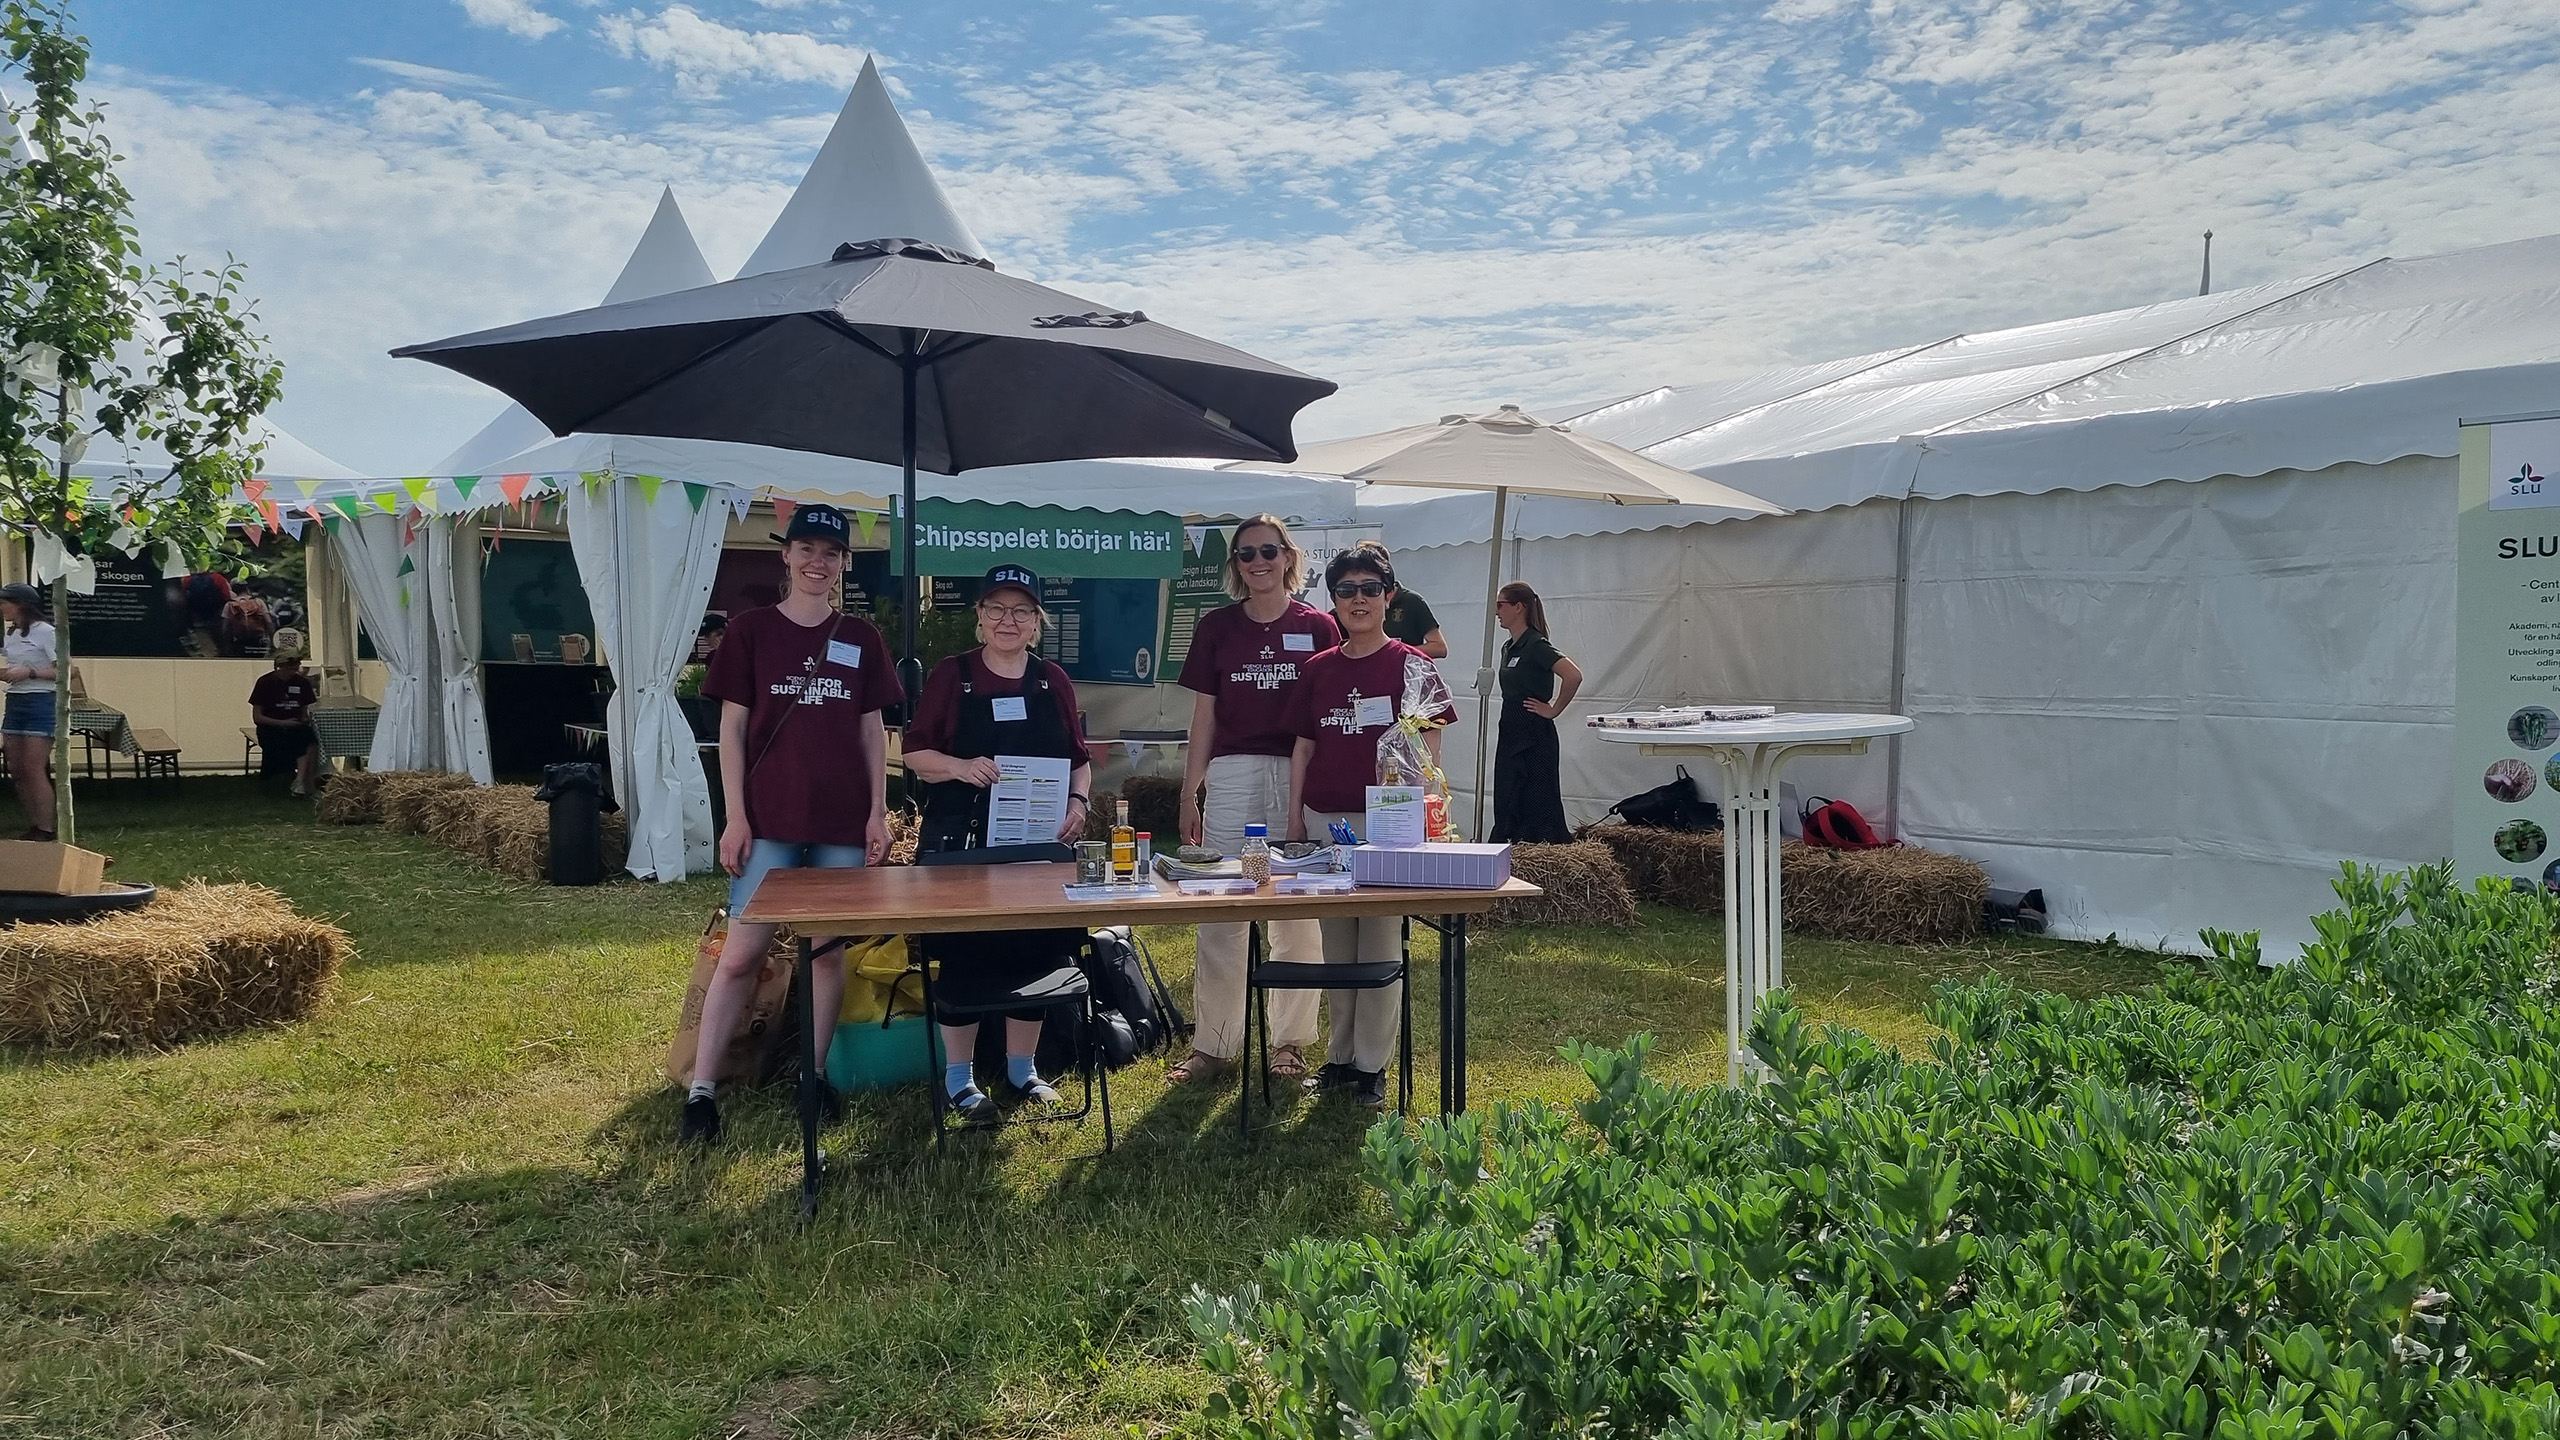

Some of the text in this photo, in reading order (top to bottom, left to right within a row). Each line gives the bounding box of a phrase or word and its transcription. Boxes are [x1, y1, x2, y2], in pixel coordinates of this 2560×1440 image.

[2511, 484, 2541, 495] SLU
[807, 512, 842, 530] SLU
[915, 524, 1171, 554] Chipsspelet börjar här!
[2498, 536, 2559, 559] SLU
[95, 560, 114, 569] sar
[101, 570, 145, 582] skogen
[1182, 565, 1200, 577] esign
[995, 569, 1031, 585] SLU
[1189, 578, 1218, 588] landskap
[2540, 594, 2555, 603] av
[2509, 622, 2550, 630] Akademi,
[2524, 633, 2536, 641] för
[2508, 648, 2554, 657] Utveckling
[1273, 663, 1296, 673] FOR
[1230, 670, 1301, 682] SUSTAINABL
[2510, 673, 2557, 682] Kunskaper
[817, 677, 842, 688] FOR
[1256, 680, 1280, 690] LIFE
[770, 684, 852, 699] SUSTINABLE
[1342, 726, 1364, 735] LIFE
